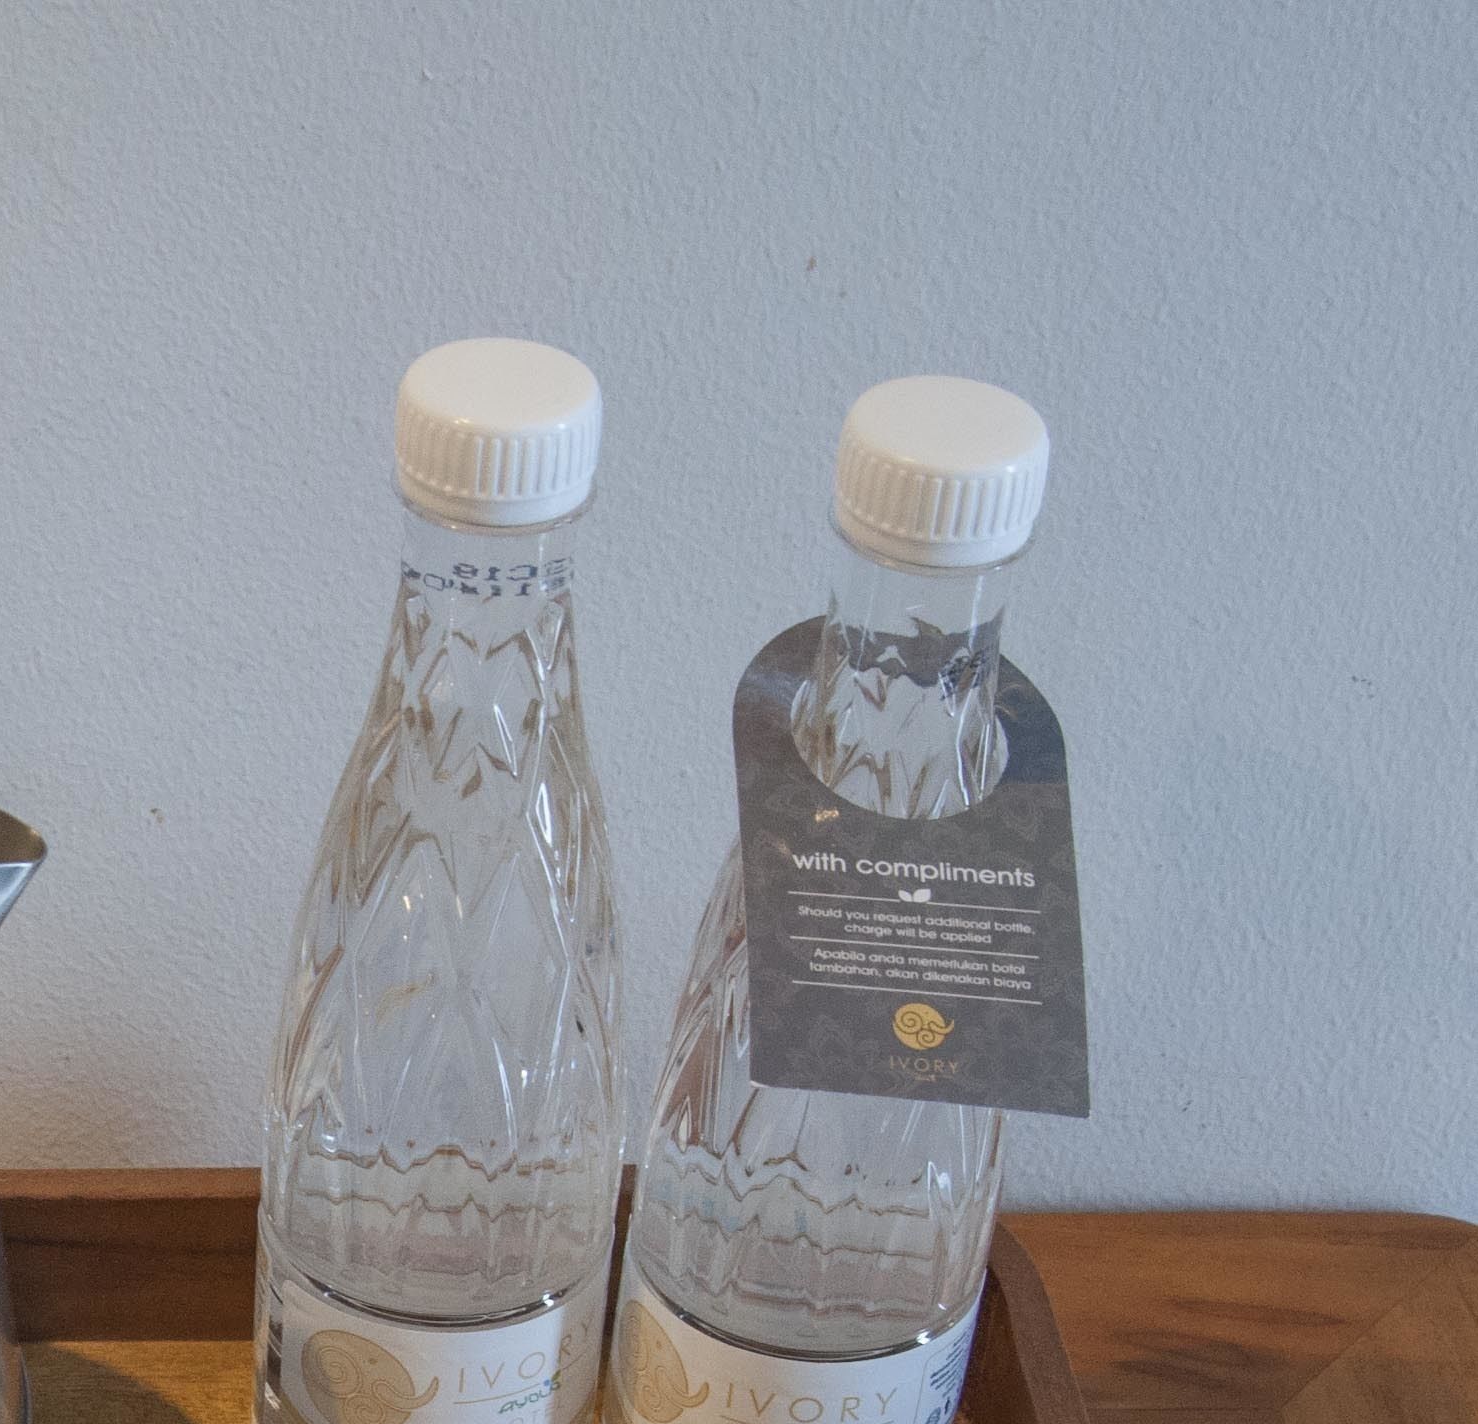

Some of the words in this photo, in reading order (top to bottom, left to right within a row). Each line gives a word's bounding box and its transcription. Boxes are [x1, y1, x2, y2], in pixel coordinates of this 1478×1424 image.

[792, 852, 847, 873] with
[856, 859, 1036, 888] compliments
[798, 905, 843, 919] Should
[846, 911, 870, 921] you
[873, 912, 922, 925] request
[925, 916, 991, 930] additional
[844, 923, 893, 938] charge
[896, 927, 916, 938] will
[919, 928, 937, 940] be
[940, 930, 992, 944] applied
[814, 948, 866, 962] Apabila
[868, 953, 905, 965] anda
[908, 956, 989, 972] memerlukan
[991, 962, 1026, 976] botol
[885, 967, 920, 980] akan
[922, 970, 991, 986] dikenakan
[993, 976, 1032, 991] biaya
[889, 1055, 959, 1074] IVORY
[725, 1383, 898, 1424] IVORY
